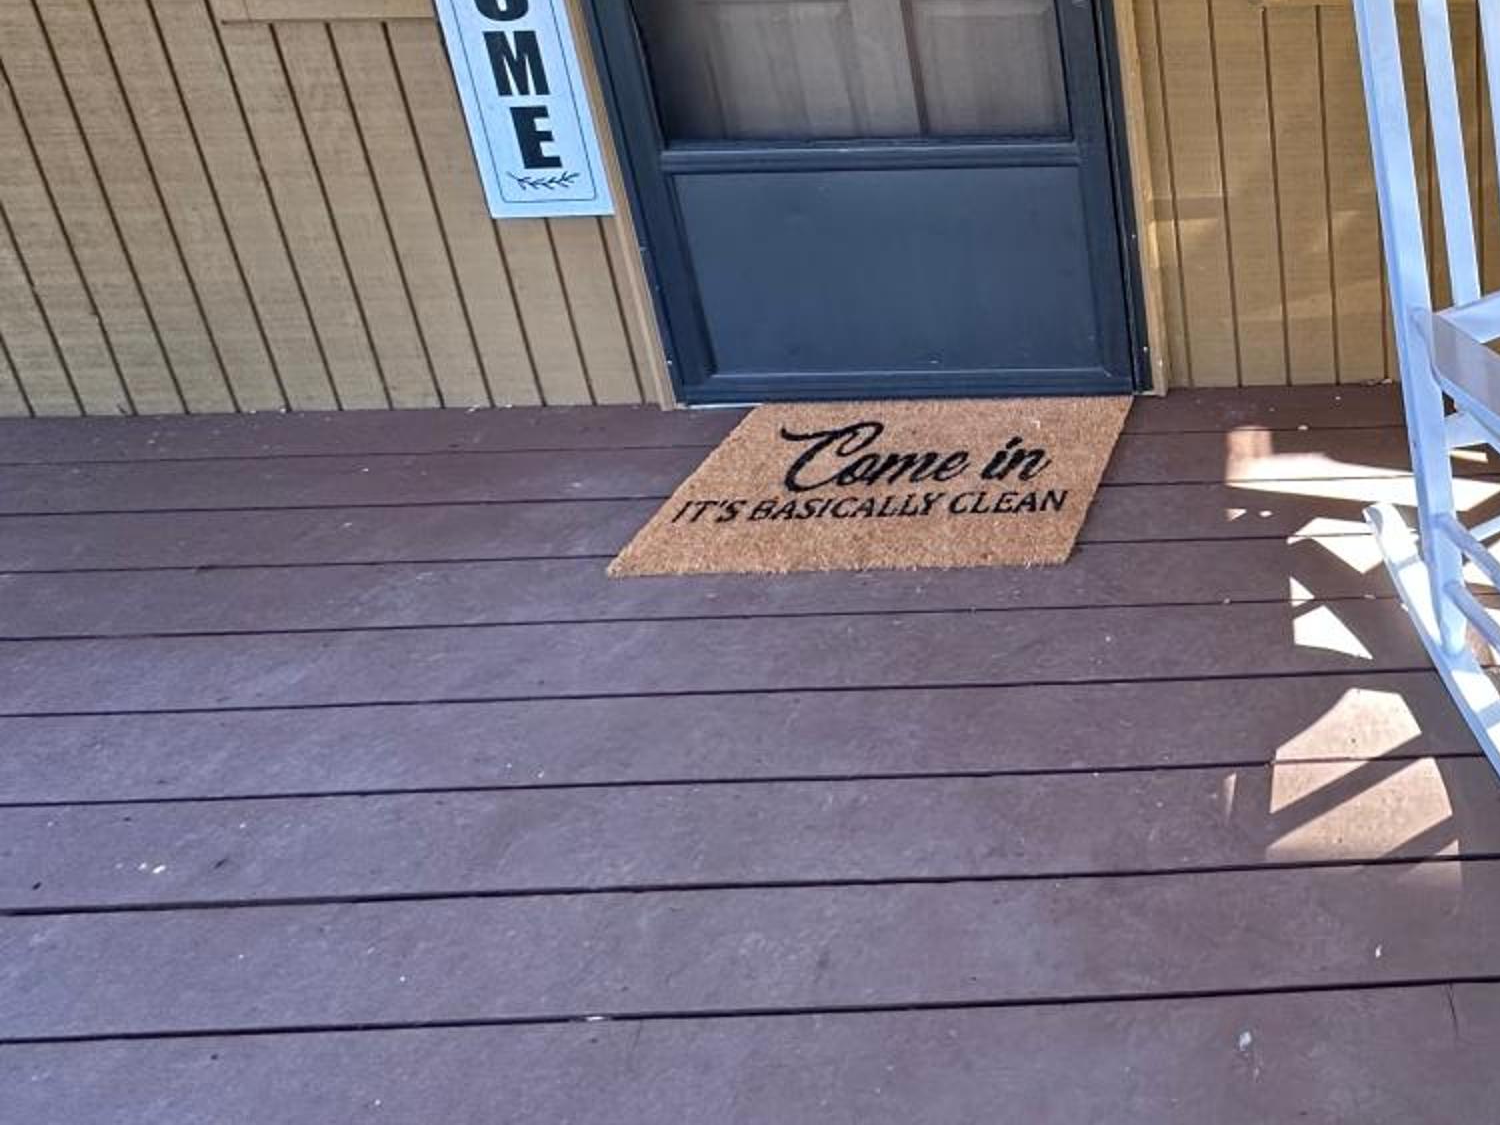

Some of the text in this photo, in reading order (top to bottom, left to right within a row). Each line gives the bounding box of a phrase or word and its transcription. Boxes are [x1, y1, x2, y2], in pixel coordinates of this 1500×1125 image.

[780, 420, 1051, 493] Come in
[671, 489, 1069, 524] IT'S BASICALLY CLEAN
